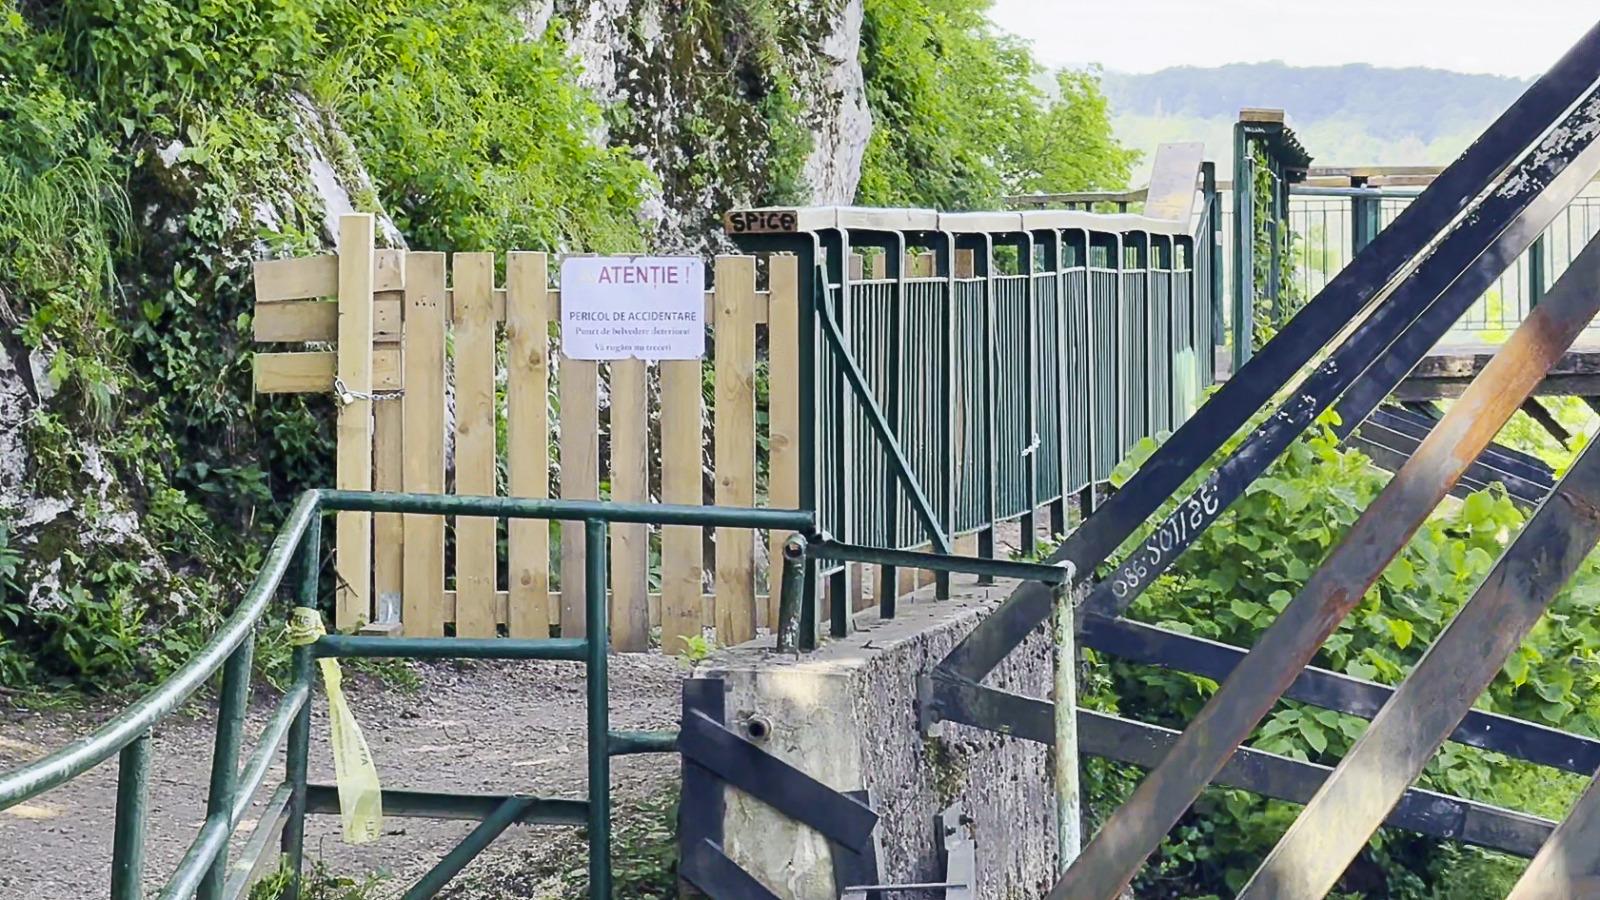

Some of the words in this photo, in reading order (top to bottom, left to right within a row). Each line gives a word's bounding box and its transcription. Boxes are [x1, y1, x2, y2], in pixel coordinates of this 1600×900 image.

[598, 266, 678, 288] ATENȚIE
[569, 311, 610, 321] PERICOL
[612, 311, 625, 321] DE
[628, 311, 697, 321] ACCIDENTARE
[600, 327, 610, 335] de
